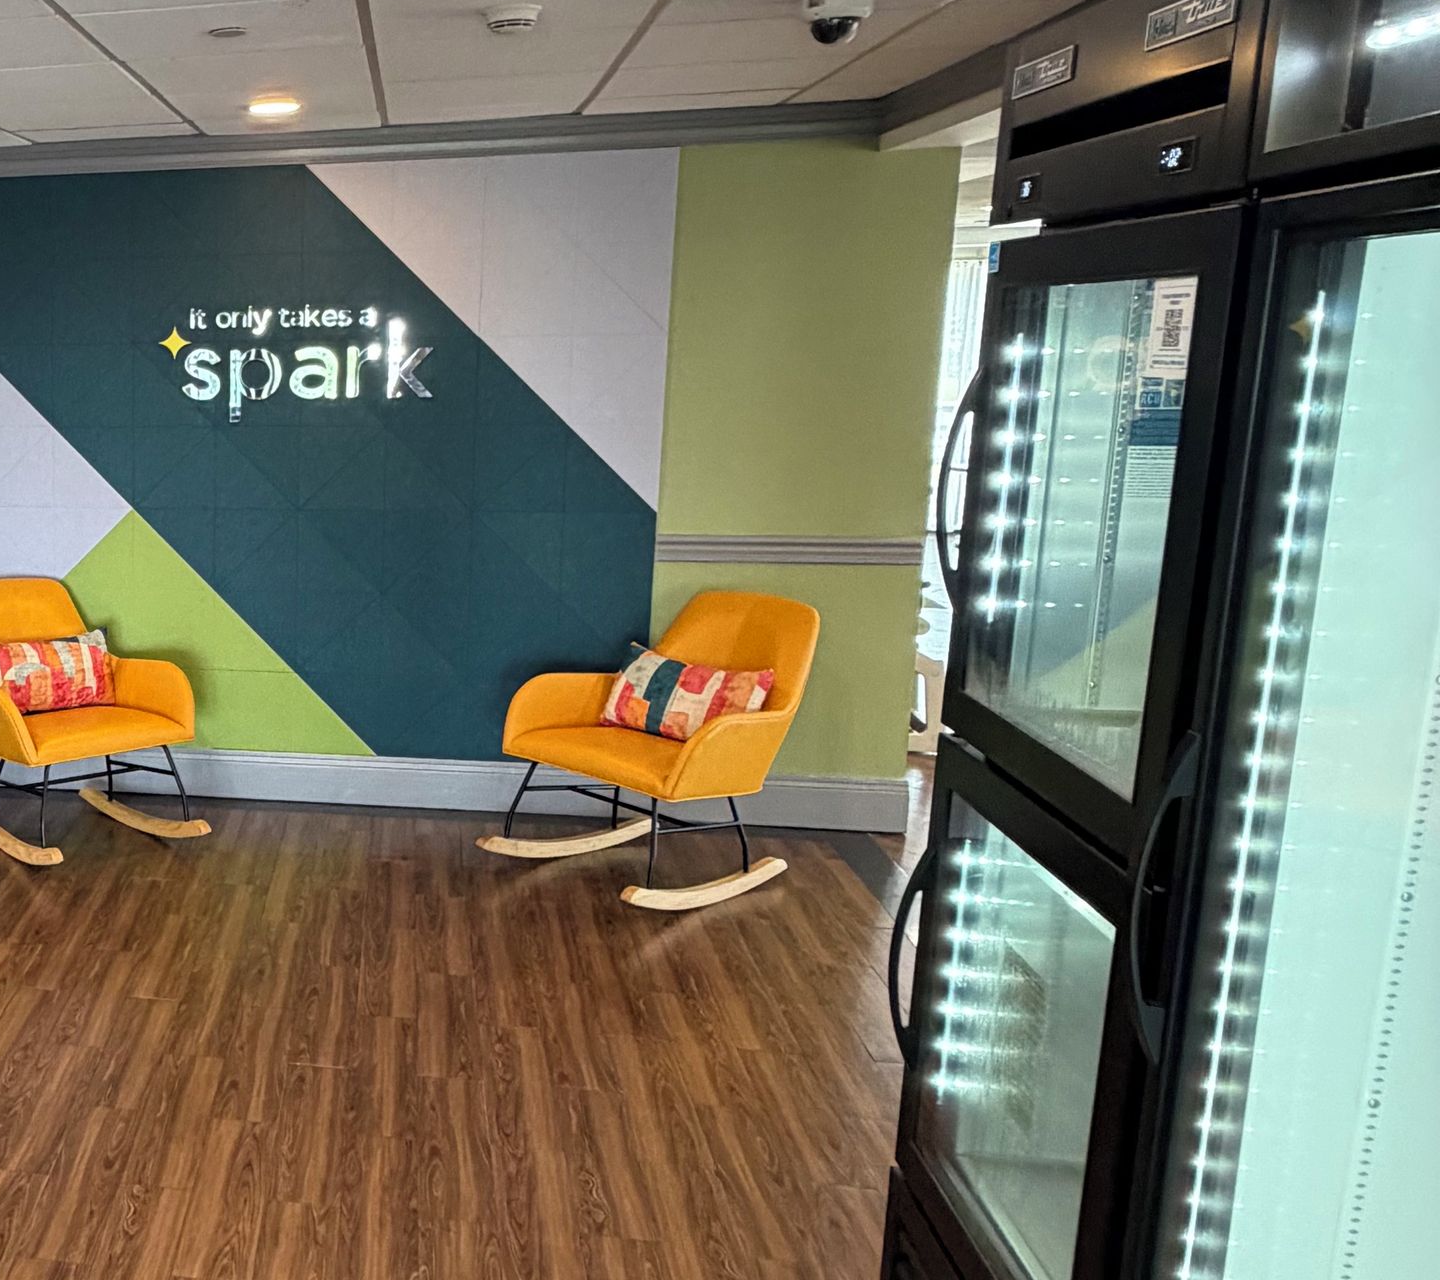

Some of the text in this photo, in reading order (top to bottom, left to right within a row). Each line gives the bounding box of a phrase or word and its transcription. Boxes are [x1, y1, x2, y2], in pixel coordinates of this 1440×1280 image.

[189, 304, 378, 336] it only takes a
[182, 317, 434, 423] spark
